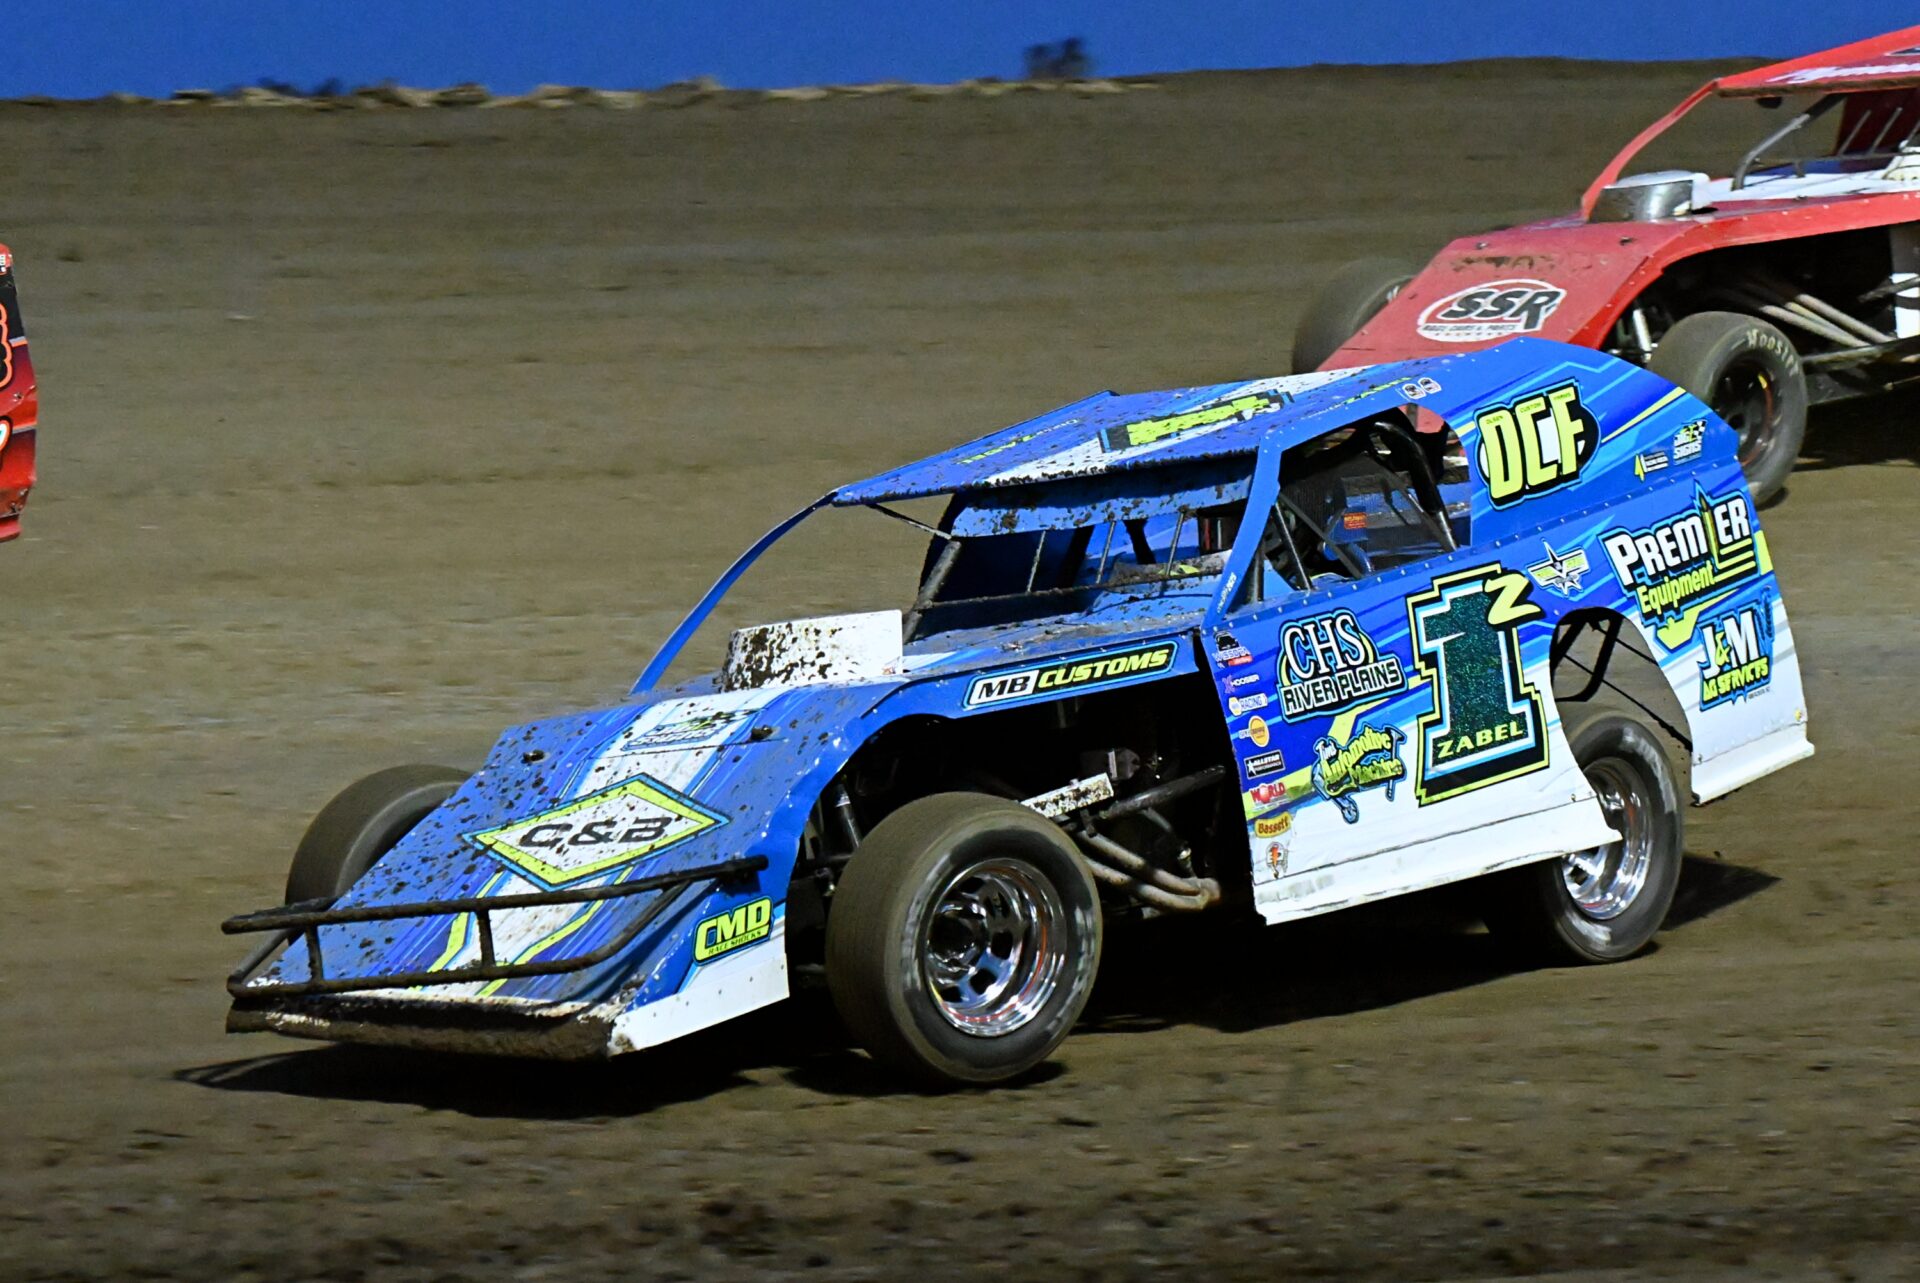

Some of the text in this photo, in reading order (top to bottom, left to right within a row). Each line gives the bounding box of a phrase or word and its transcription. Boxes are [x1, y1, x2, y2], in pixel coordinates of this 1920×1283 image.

[1440, 289, 1561, 330] SSR
[1604, 494, 1751, 586] PREMIER
[1636, 559, 1716, 616] Equipment
[1284, 614, 1366, 679] CHS
[1702, 610, 1760, 680] J&M
[978, 649, 1170, 700] MB CUSTOMS
[1239, 695, 1263, 710] RACING
[1282, 658, 1403, 715] RIVER PLAINS
[1253, 753, 1280, 766] ALLSTAR
[1321, 727, 1392, 784] Automotive
[1437, 721, 1524, 759] ZABEL
[1257, 816, 1289, 834] Bassett
[695, 899, 771, 960] CMD
